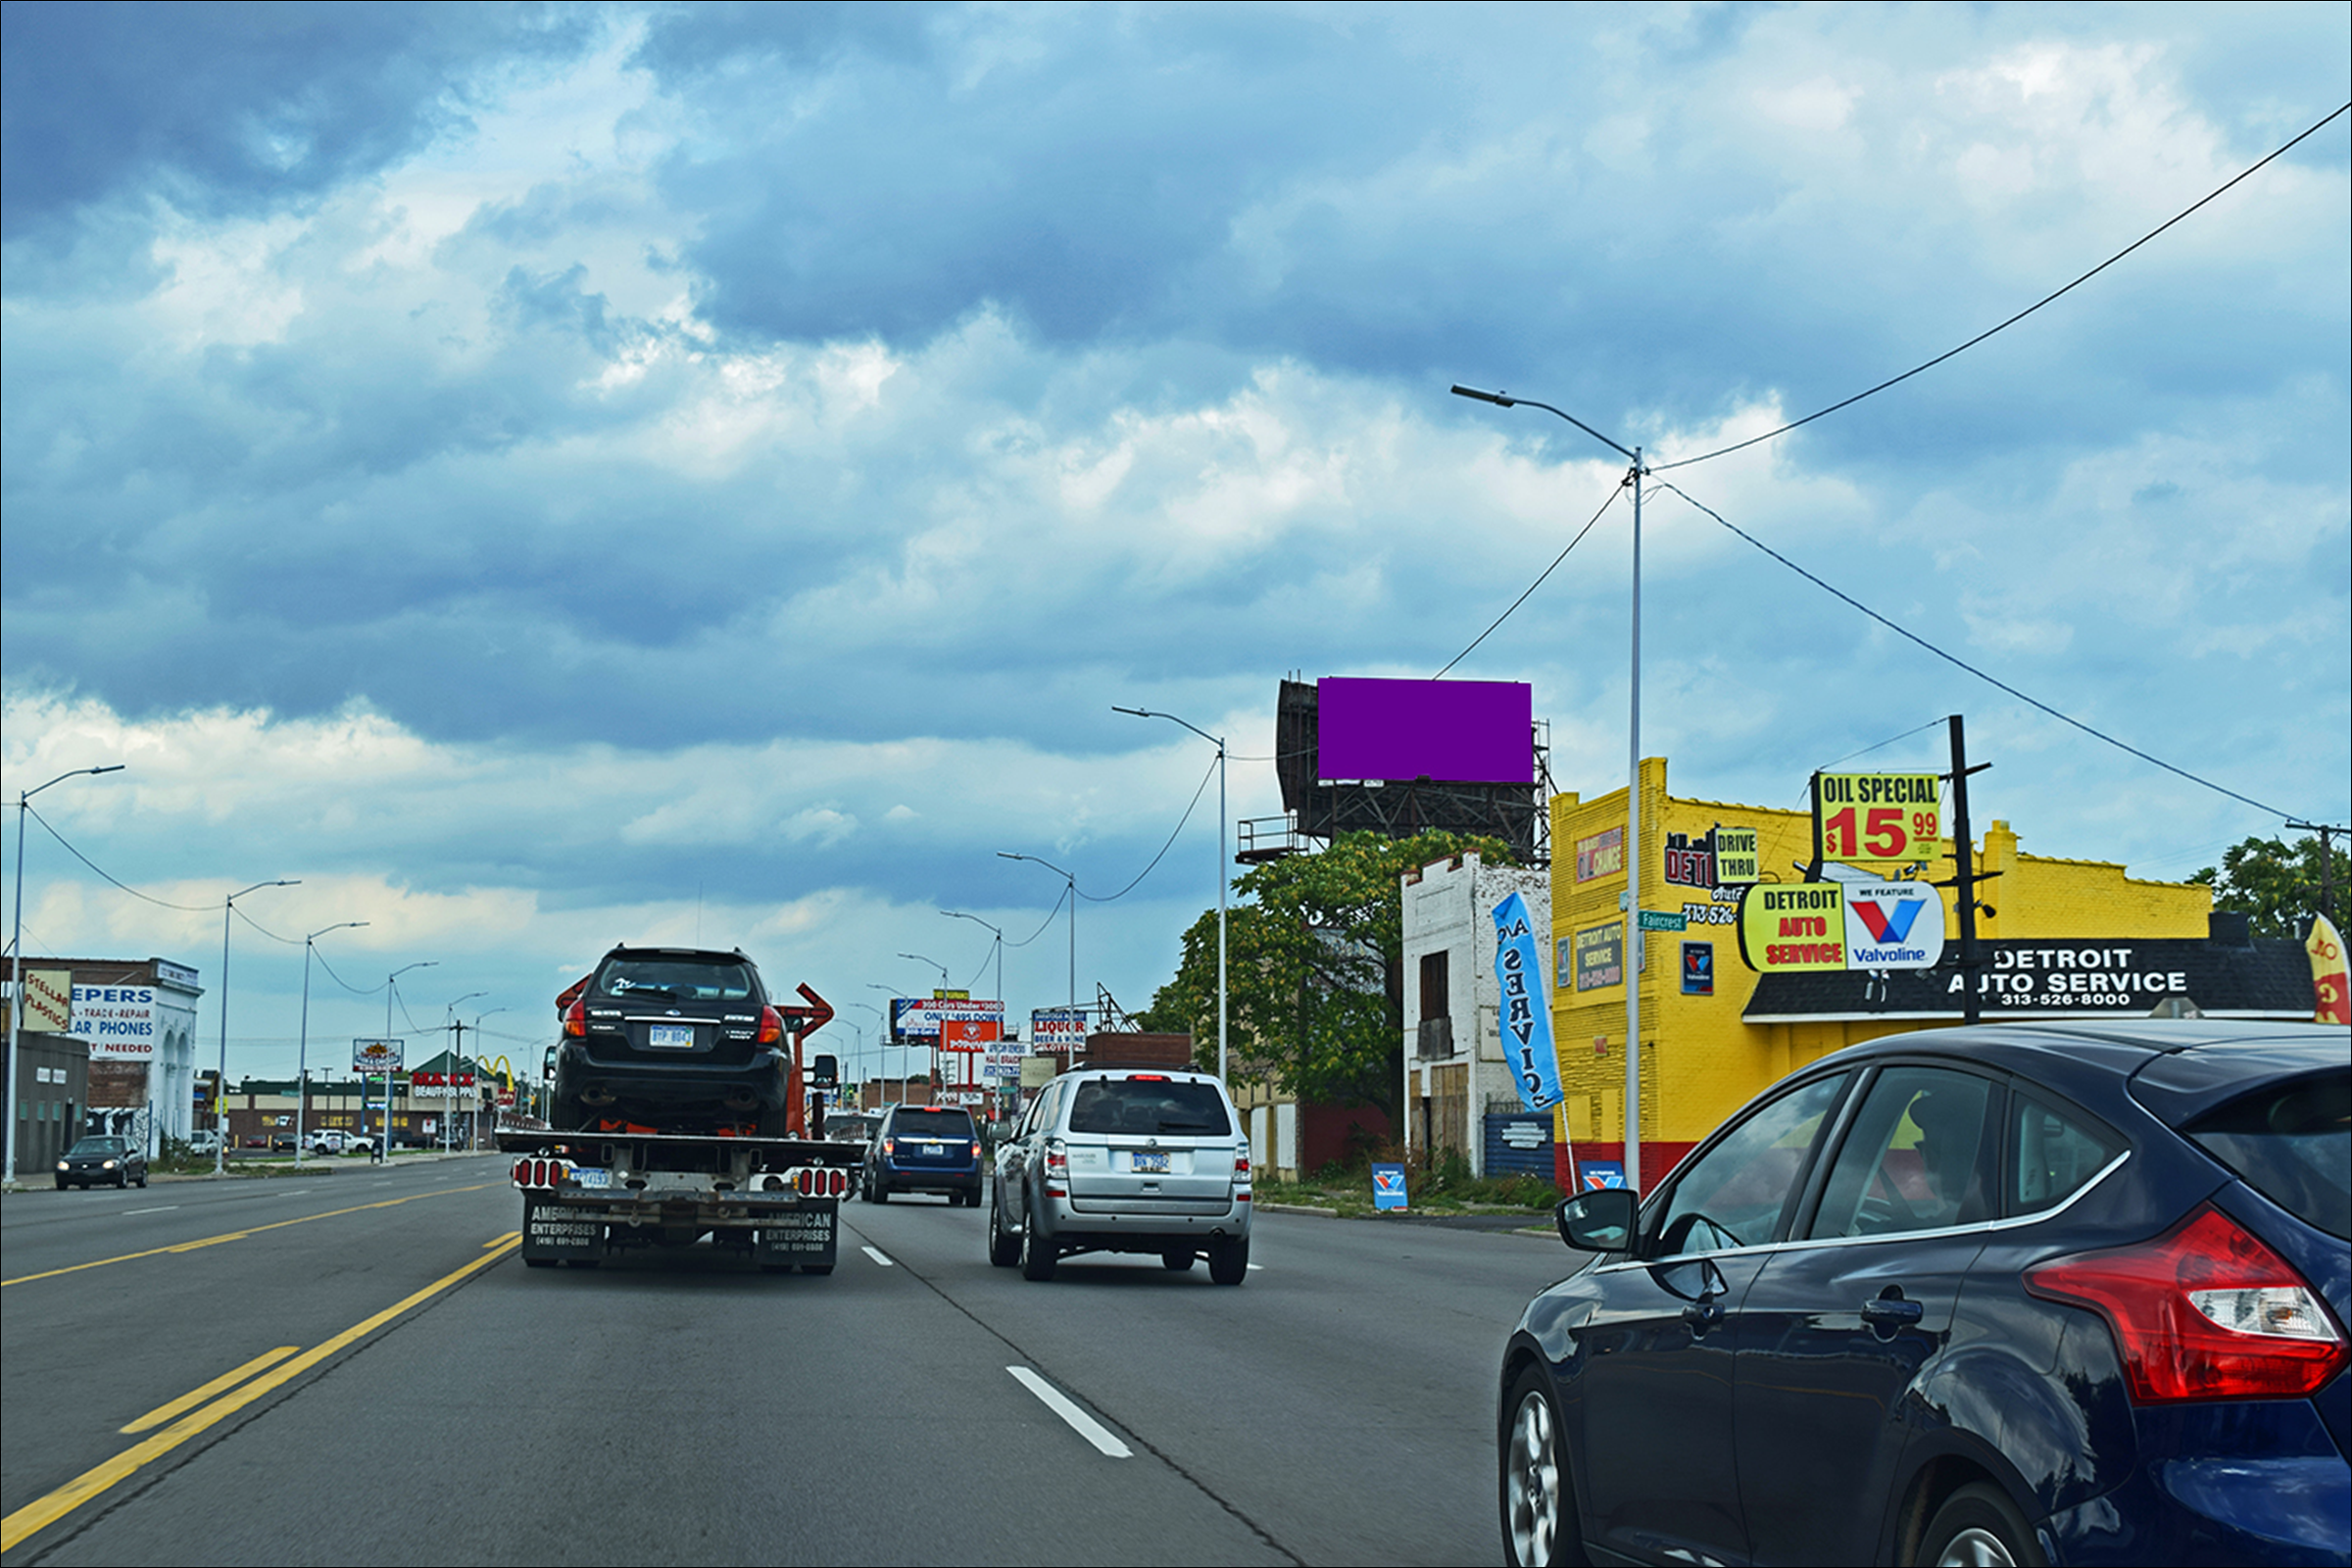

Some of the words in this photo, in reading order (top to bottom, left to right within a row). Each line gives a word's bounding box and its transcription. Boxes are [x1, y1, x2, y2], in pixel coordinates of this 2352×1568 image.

[1824, 777, 1854, 803] OIL
[1858, 777, 1937, 803] SPECIAL
[1718, 834, 1756, 852] DRIVE
[1578, 854, 1593, 880] OIL
[1593, 846, 1622, 877] CHANGE
[1720, 858, 1755, 876] THRU
[1764, 890, 1838, 910] DETROIT
[1875, 888, 1915, 897] FEATURE
[1642, 912, 1682, 929] Faircrest
[1779, 916, 1828, 938] AUTO
[1577, 927, 1603, 950] DETROIT
[1604, 923, 1622, 942] AUTO
[1585, 947, 1612, 968] SERVICE
[1766, 943, 1843, 965] SERVICE
[1853, 948, 1927, 963] Valvoline
[1994, 949, 2132, 969] DETROIT
[27, 973, 69, 1007] STELLAR
[2047, 972, 2187, 993] SERVICE
[72, 988, 153, 1004] EPERS
[2001, 993, 2131, 1005] 313-526-8000
[24, 994, 69, 1030] PLASTICS
[99, 1021, 153, 1036] PHONES
[105, 1043, 153, 1054] NEEDED
[1064, 1035, 1085, 1044] WNE
[413, 1071, 474, 1086] MAXX
[448, 1085, 477, 1098] SPPLY
[530, 1222, 597, 1236] ENTERPRISES
[765, 1229, 831, 1242] ENTERPRISES
